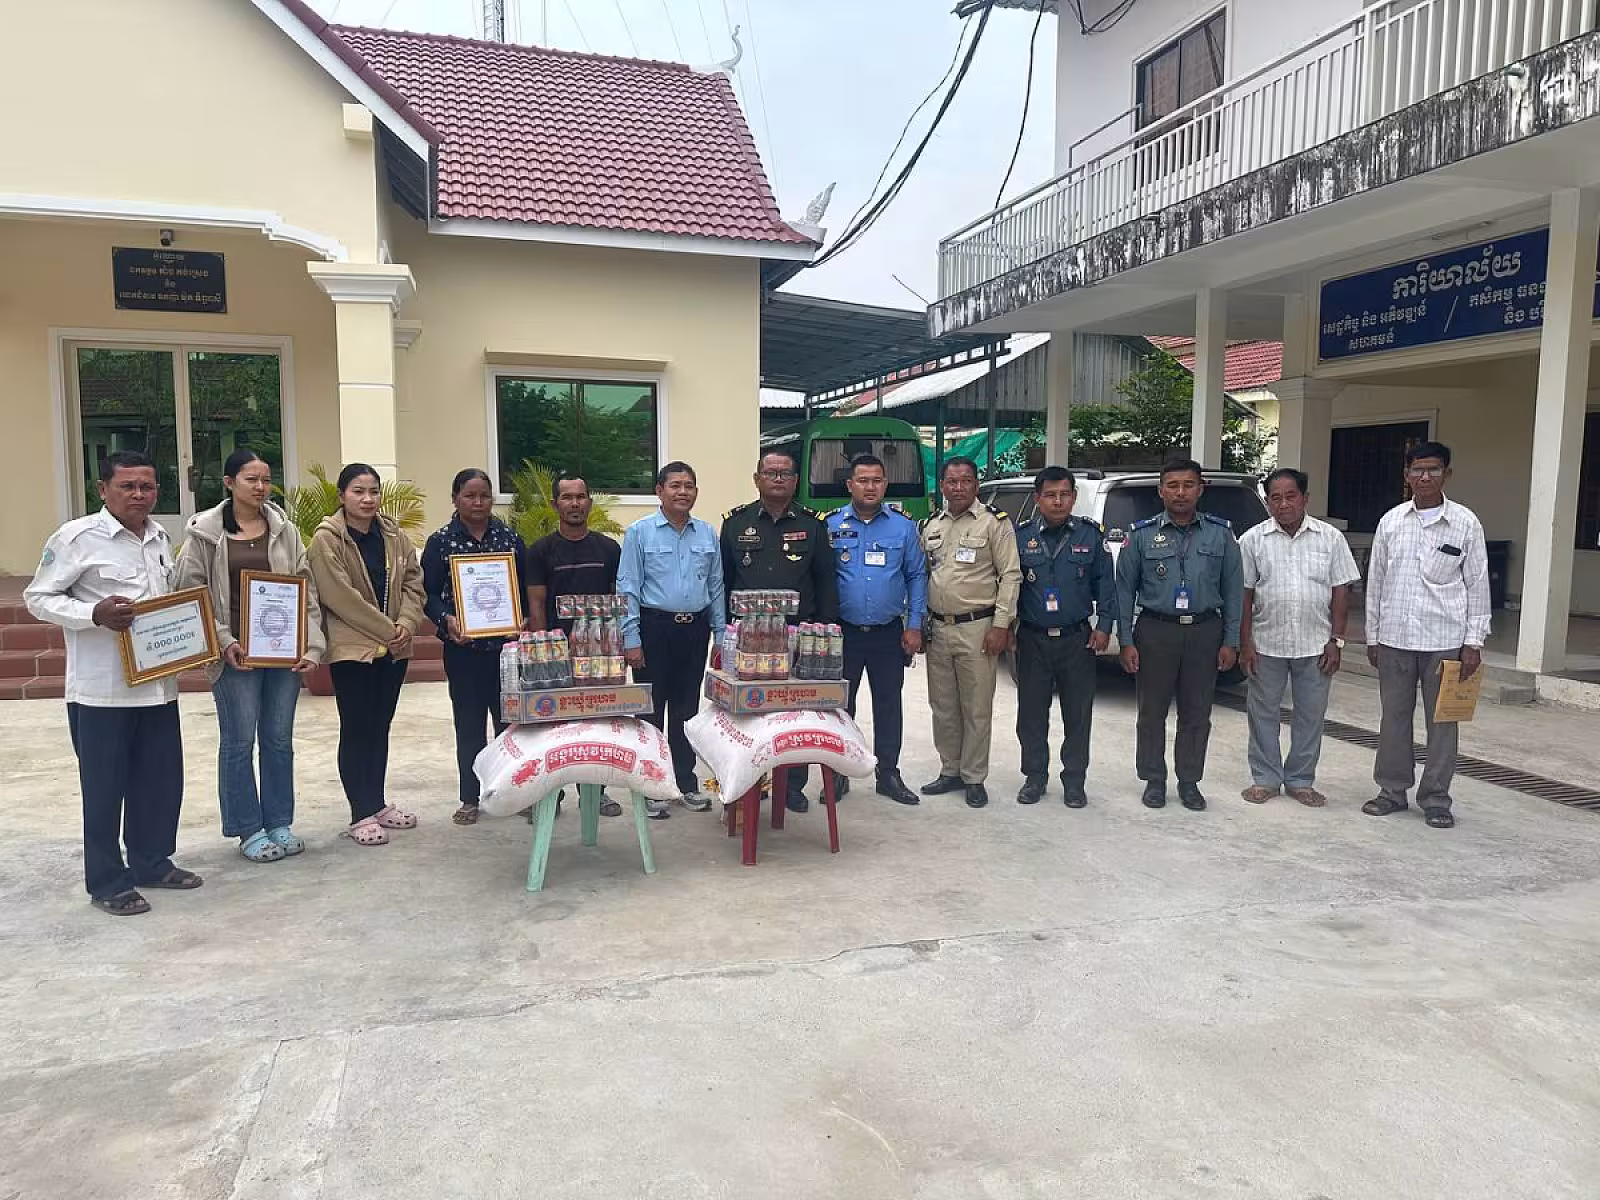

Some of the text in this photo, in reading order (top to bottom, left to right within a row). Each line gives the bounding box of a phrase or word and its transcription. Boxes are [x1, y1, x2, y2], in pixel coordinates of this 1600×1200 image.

[1392, 245, 1521, 300] ការិយាល័យ
[1469, 286, 1513, 307] កសិកម្ម
[1323, 314, 1359, 336] សេដ្ឋកិច្ច
[1362, 310, 1377, 328] និង
[1503, 306, 1525, 325] និង
[1350, 326, 1395, 350] សហគមន៍
